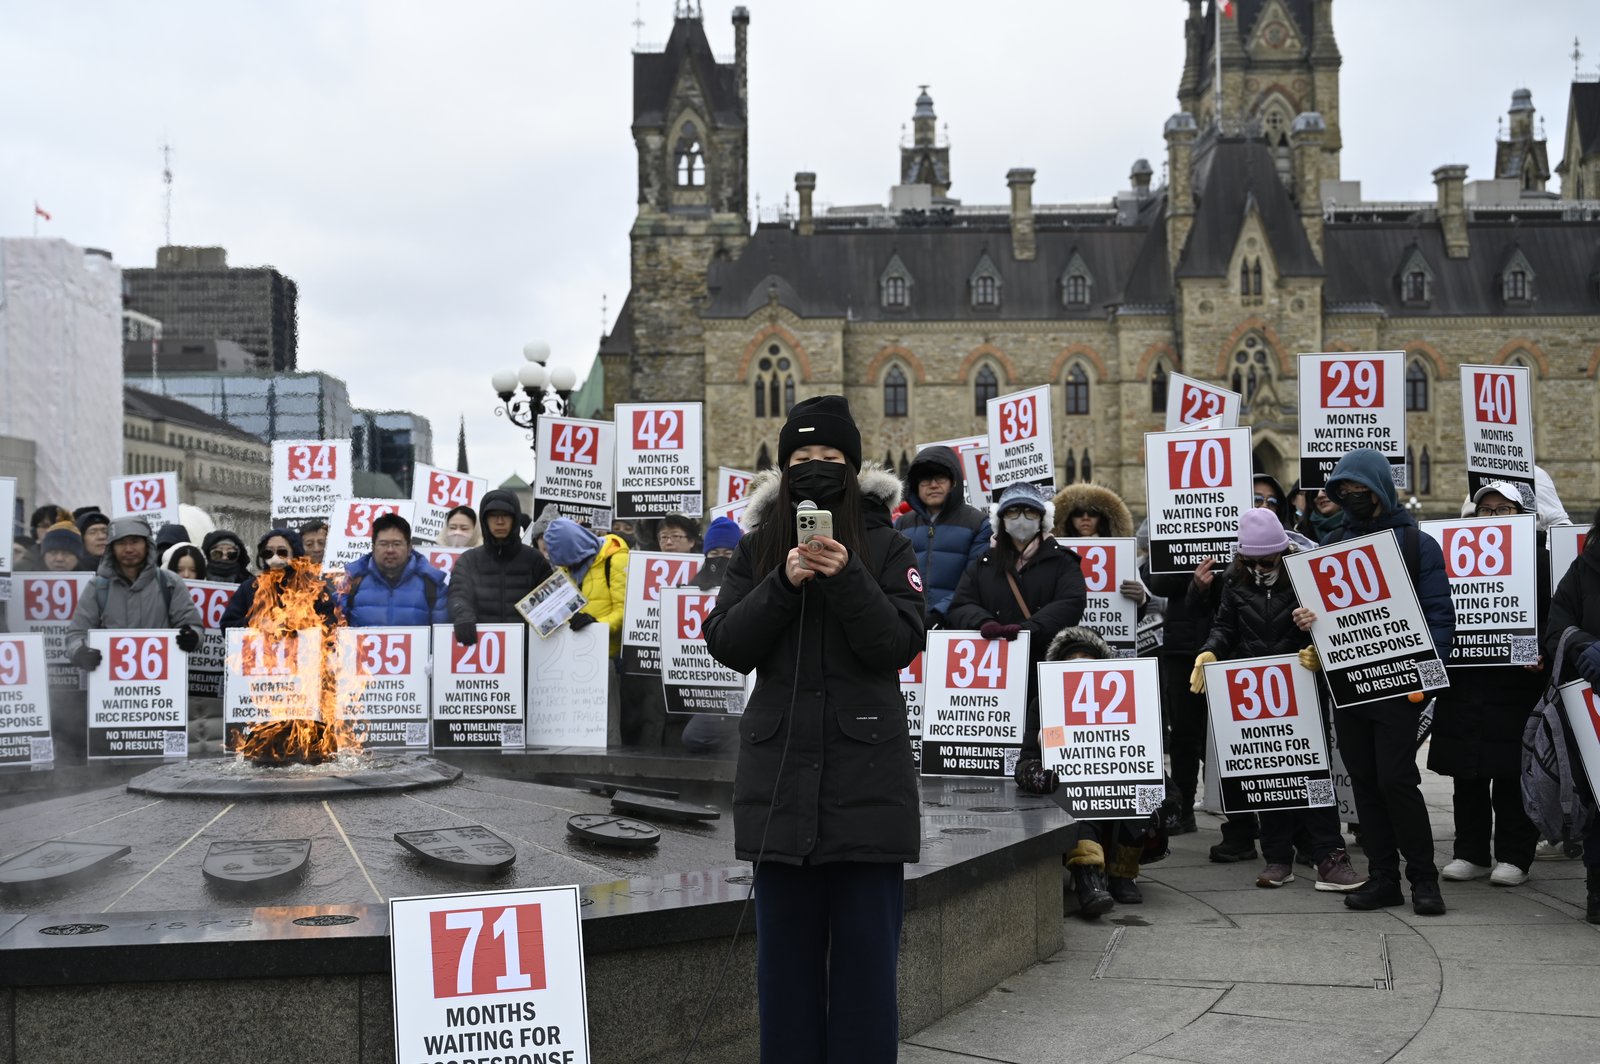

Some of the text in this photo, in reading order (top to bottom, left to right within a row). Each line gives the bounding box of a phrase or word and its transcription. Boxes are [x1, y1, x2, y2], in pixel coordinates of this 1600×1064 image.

[1327, 361, 1377, 407] 29
[1479, 375, 1511, 423] 40
[1184, 388, 1219, 424] 23
[1003, 398, 1032, 442] 39
[1327, 414, 1377, 424] MONTHS
[638, 411, 678, 448] 42
[1315, 428, 1390, 438] WAITING FOR
[1481, 429, 1513, 442] MONTHS
[556, 426, 593, 464] 42
[1005, 443, 1034, 457] MONTHS
[1308, 442, 1333, 452] IRCC
[1474, 442, 1523, 457] WAITING FOR
[293, 446, 332, 479] 34
[638, 454, 678, 463] MONTHS
[998, 453, 1043, 471] WAITING FOR
[1175, 440, 1224, 488] 70
[1471, 456, 1529, 472] IRCC RESPONSE
[556, 467, 593, 478] MONTHS
[628, 466, 689, 475] WAITING FOR
[1320, 462, 1332, 470] NO
[995, 464, 1048, 484] IRCC RESPONSE
[546, 477, 602, 490] WAITING FOR
[622, 477, 695, 486] IRCC RESPONSE
[129, 480, 162, 511] 62
[432, 475, 468, 506] 34
[540, 487, 607, 501] IRCC RESPONSE
[645, 494, 681, 502] TIMELINE
[1175, 492, 1224, 505] MONTHS
[560, 504, 593, 514] TIMELINE
[635, 504, 646, 512] NO
[1163, 506, 1238, 520] WAITING FOR
[287, 520, 297, 528] NO
[1156, 521, 1238, 534] IRCC RESPONS
[415, 526, 433, 536] IRCC
[1169, 542, 1230, 553] NO TIMELINE
[1451, 527, 1504, 577] 68
[1174, 555, 1187, 564] NO
[649, 560, 690, 600] 34
[1320, 550, 1380, 608] 30
[1451, 582, 1504, 595] MONTHS
[30, 581, 72, 619] 39
[1456, 596, 1519, 609] ITING FOR
[1100, 612, 1122, 622] FOR
[1336, 607, 1390, 629] MONTHS
[1458, 611, 1527, 624] RESPONSE
[636, 619, 659, 630] WAIT
[629, 631, 650, 641] IRCC
[1329, 619, 1410, 646] WAITING FOR
[1457, 634, 1513, 645] TIMELINES
[362, 635, 406, 674] 35
[456, 632, 500, 673] 20
[638, 650, 649, 658] NO
[681, 645, 708, 655] MONT
[1327, 633, 1423, 664] IRCC RESPONSE
[1463, 646, 1509, 657] RESULTS
[115, 638, 162, 680] 36
[250, 639, 290, 675] 11
[672, 658, 710, 668] WAITING
[640, 660, 652, 669] NO
[952, 640, 1001, 688] 34
[1347, 659, 1416, 682] NO TIMELINES
[668, 670, 737, 682] IRCC RESPONSE
[456, 680, 499, 689] MONTHS
[1356, 673, 1418, 694] NO RESULTS
[114, 686, 161, 696] MONTHS
[396, 692, 416, 701] FOR
[445, 692, 510, 701] WAITING FOR
[679, 689, 728, 698] NO TIMELINE
[1072, 671, 1128, 723] 42
[1235, 666, 1289, 719] 30
[102, 699, 173, 709] WAITING FOR
[684, 699, 728, 708] NO RESULTS
[950, 696, 998, 707] MONTHS
[232, 708, 255, 717] IRCC
[367, 705, 422, 714] RESPONSE
[439, 705, 516, 714] IRCC RESPONSE
[938, 710, 1010, 722] WAITING FOR
[96, 711, 179, 722] IRCC RESPONSE
[367, 723, 406, 731] TIMELINE
[450, 723, 501, 731] NO TIMELINE
[930, 725, 1017, 737] IRCC RESPONSE
[1241, 724, 1294, 739] MONTHS
[106, 731, 119, 739] NO
[370, 733, 406, 741] RESULTS
[454, 733, 502, 741] NO RESULTS
[1073, 730, 1130, 743] MONTHS
[110, 741, 164, 750] NO RESULTS
[940, 746, 1004, 757] NO TIMELINES
[1231, 738, 1310, 755] WAITING FOR
[1060, 746, 1145, 759] WAITING FOR
[944, 759, 1000, 769] NO RESULTS
[1053, 761, 1155, 776] IRCC RESPONSE
[1226, 753, 1320, 771] IRCC RESPONSE
[1241, 776, 1309, 790] NO TIMELINES
[1067, 785, 1135, 797] NO TIMELINE
[1247, 789, 1307, 803] NO RESULTS
[1073, 799, 1136, 810] NO RESULTS
[446, 907, 531, 994] 71
[446, 1002, 536, 1027] MONTHS
[424, 1026, 561, 1055] WAITING FOR
